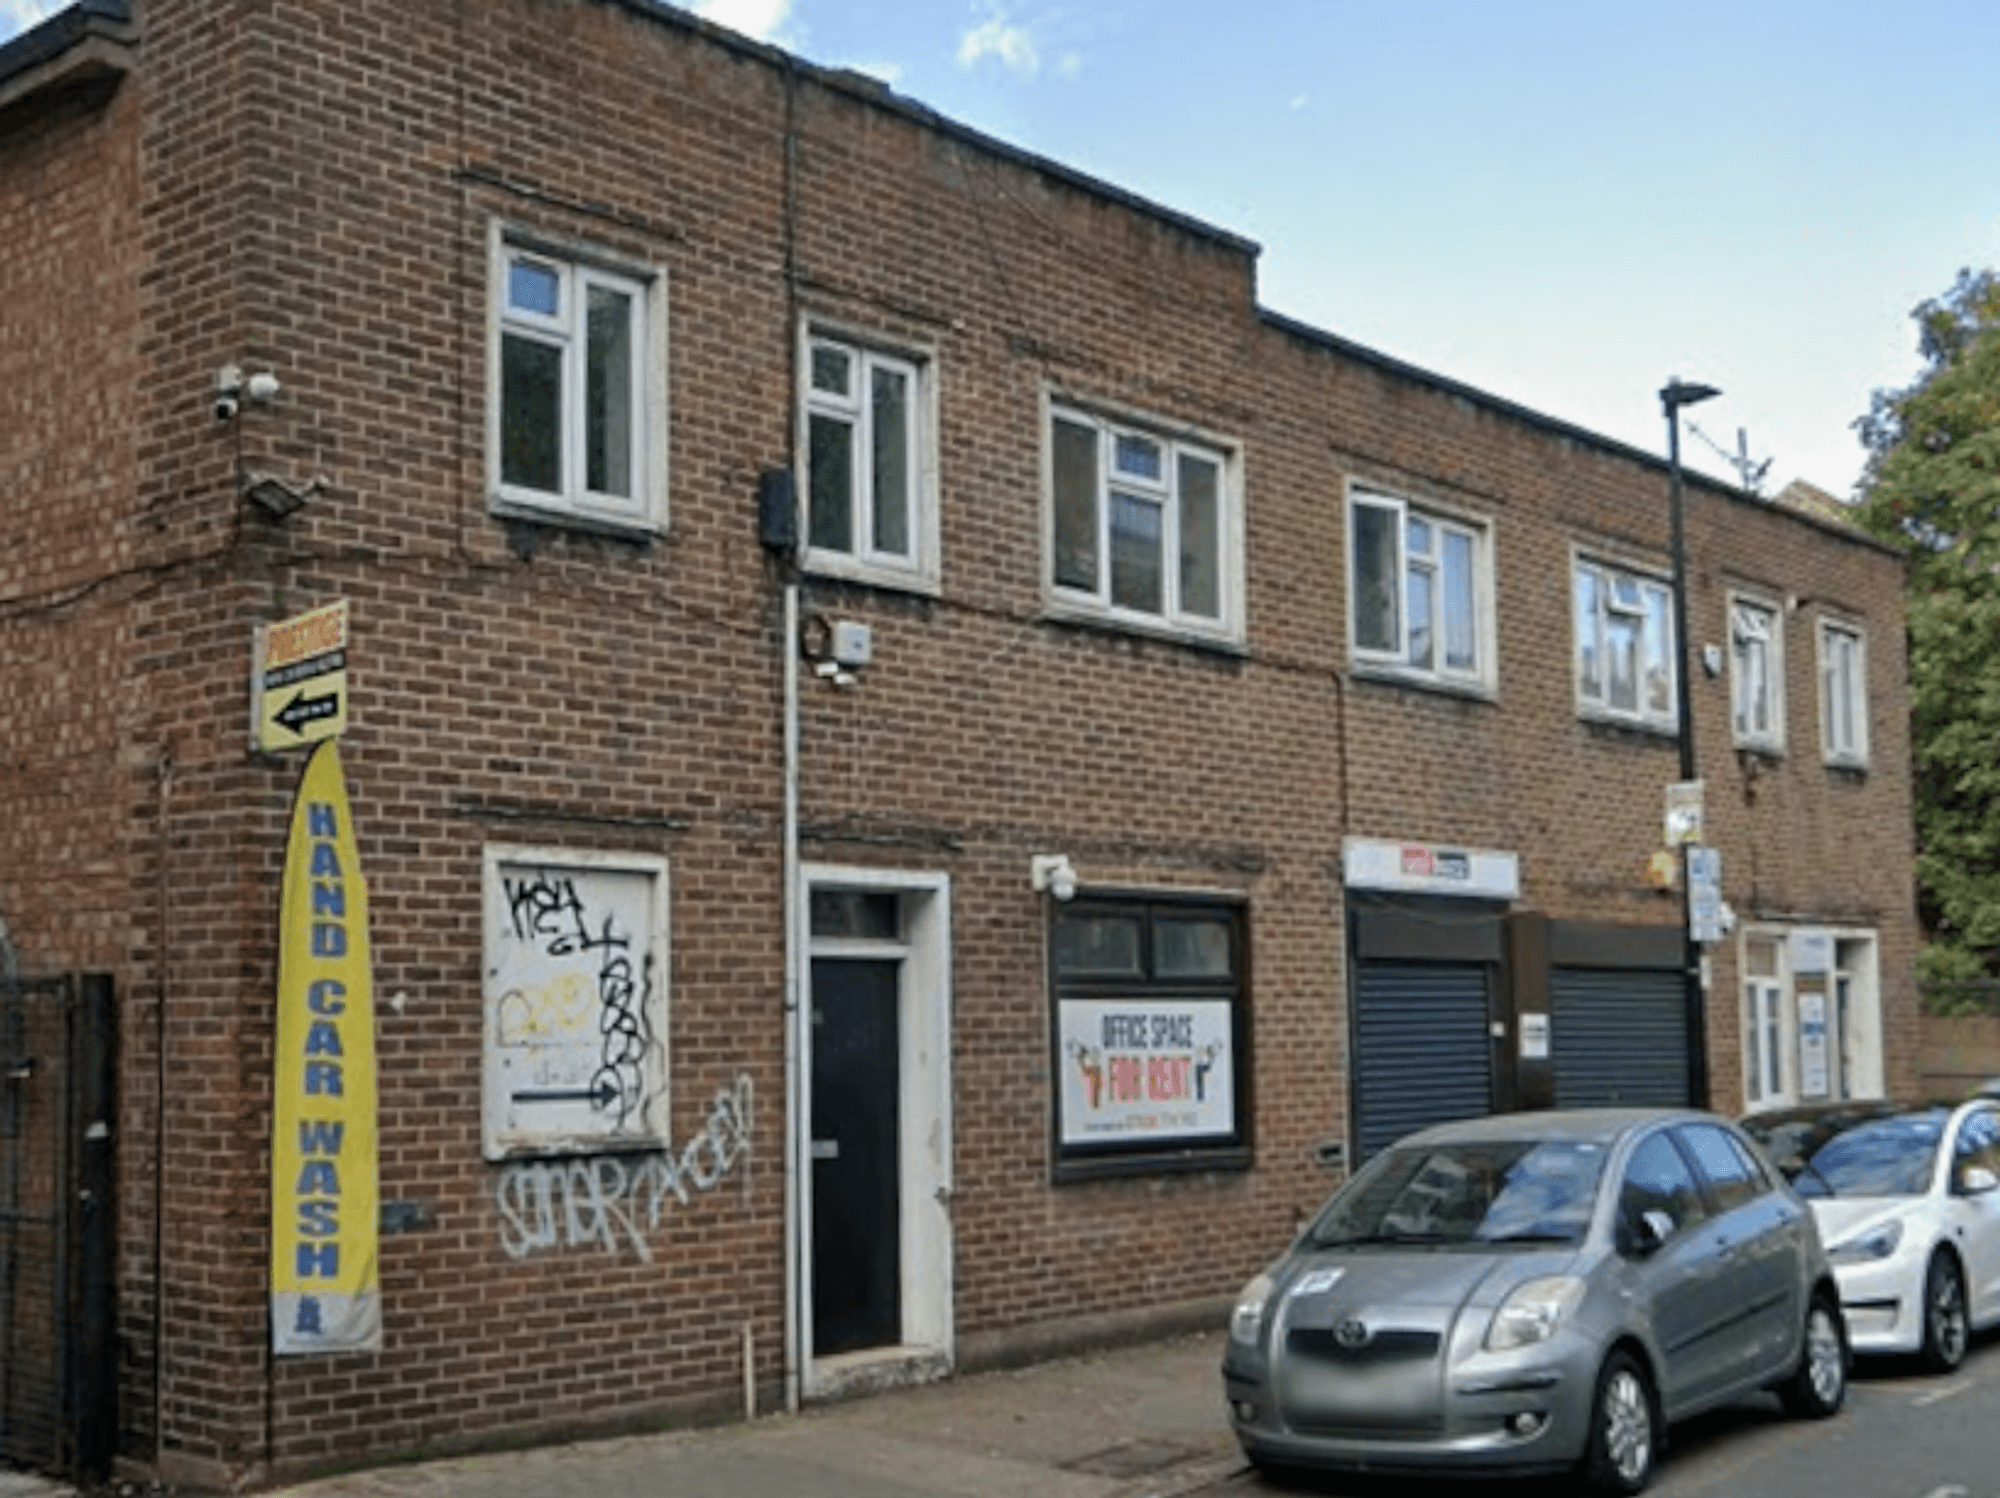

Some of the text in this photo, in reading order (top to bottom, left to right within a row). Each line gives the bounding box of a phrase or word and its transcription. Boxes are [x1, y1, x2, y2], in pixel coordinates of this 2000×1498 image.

[308, 802, 347, 958] HAND
[304, 978, 347, 1098] CAR
[1103, 1013, 1193, 1049] OFFICE SPACE
[1108, 1055, 1192, 1103] FOR RENT
[295, 1119, 344, 1279] WASH
